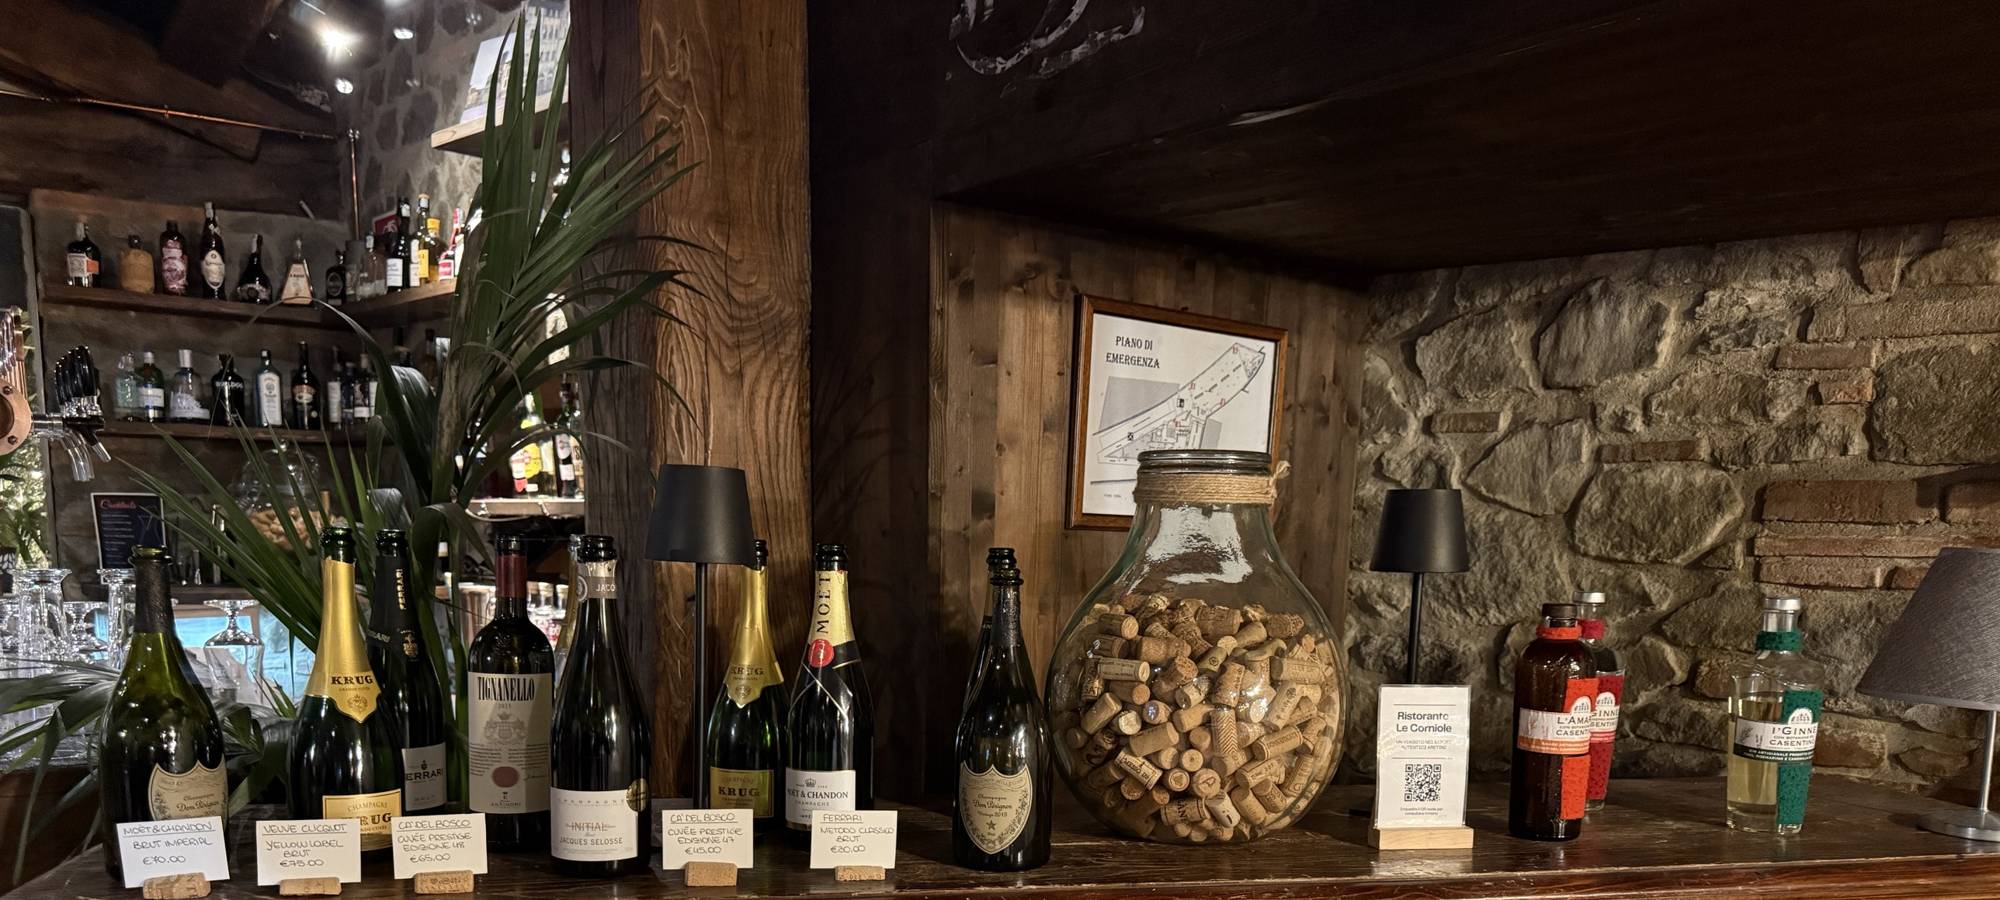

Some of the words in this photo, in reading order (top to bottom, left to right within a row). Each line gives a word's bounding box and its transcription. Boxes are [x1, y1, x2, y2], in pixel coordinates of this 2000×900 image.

[1115, 336, 1143, 349] PIANO
[1144, 339, 1153, 350] DI
[1106, 352, 1160, 368] EMERGENZA
[331, 674, 373, 685] KRUG
[477, 676, 535, 701] TIGNANELLO
[1397, 711, 1449, 721] Ristorante
[1396, 723, 1408, 733] Le
[1410, 723, 1452, 733] Corniole
[405, 768, 444, 781] ERRARI
[718, 785, 760, 796] KRUG
[807, 791, 849, 799] CHANDON
[704, 812, 736, 822] BOSCO
[823, 813, 862, 822] FERRARI
[263, 824, 297, 834] VEUVE
[571, 821, 608, 832] INITIAL
[133, 841, 161, 850] BRUT
[560, 836, 588, 846] JACQUES
[590, 837, 623, 846] SELOSSE
[283, 849, 311, 858] BRUT
